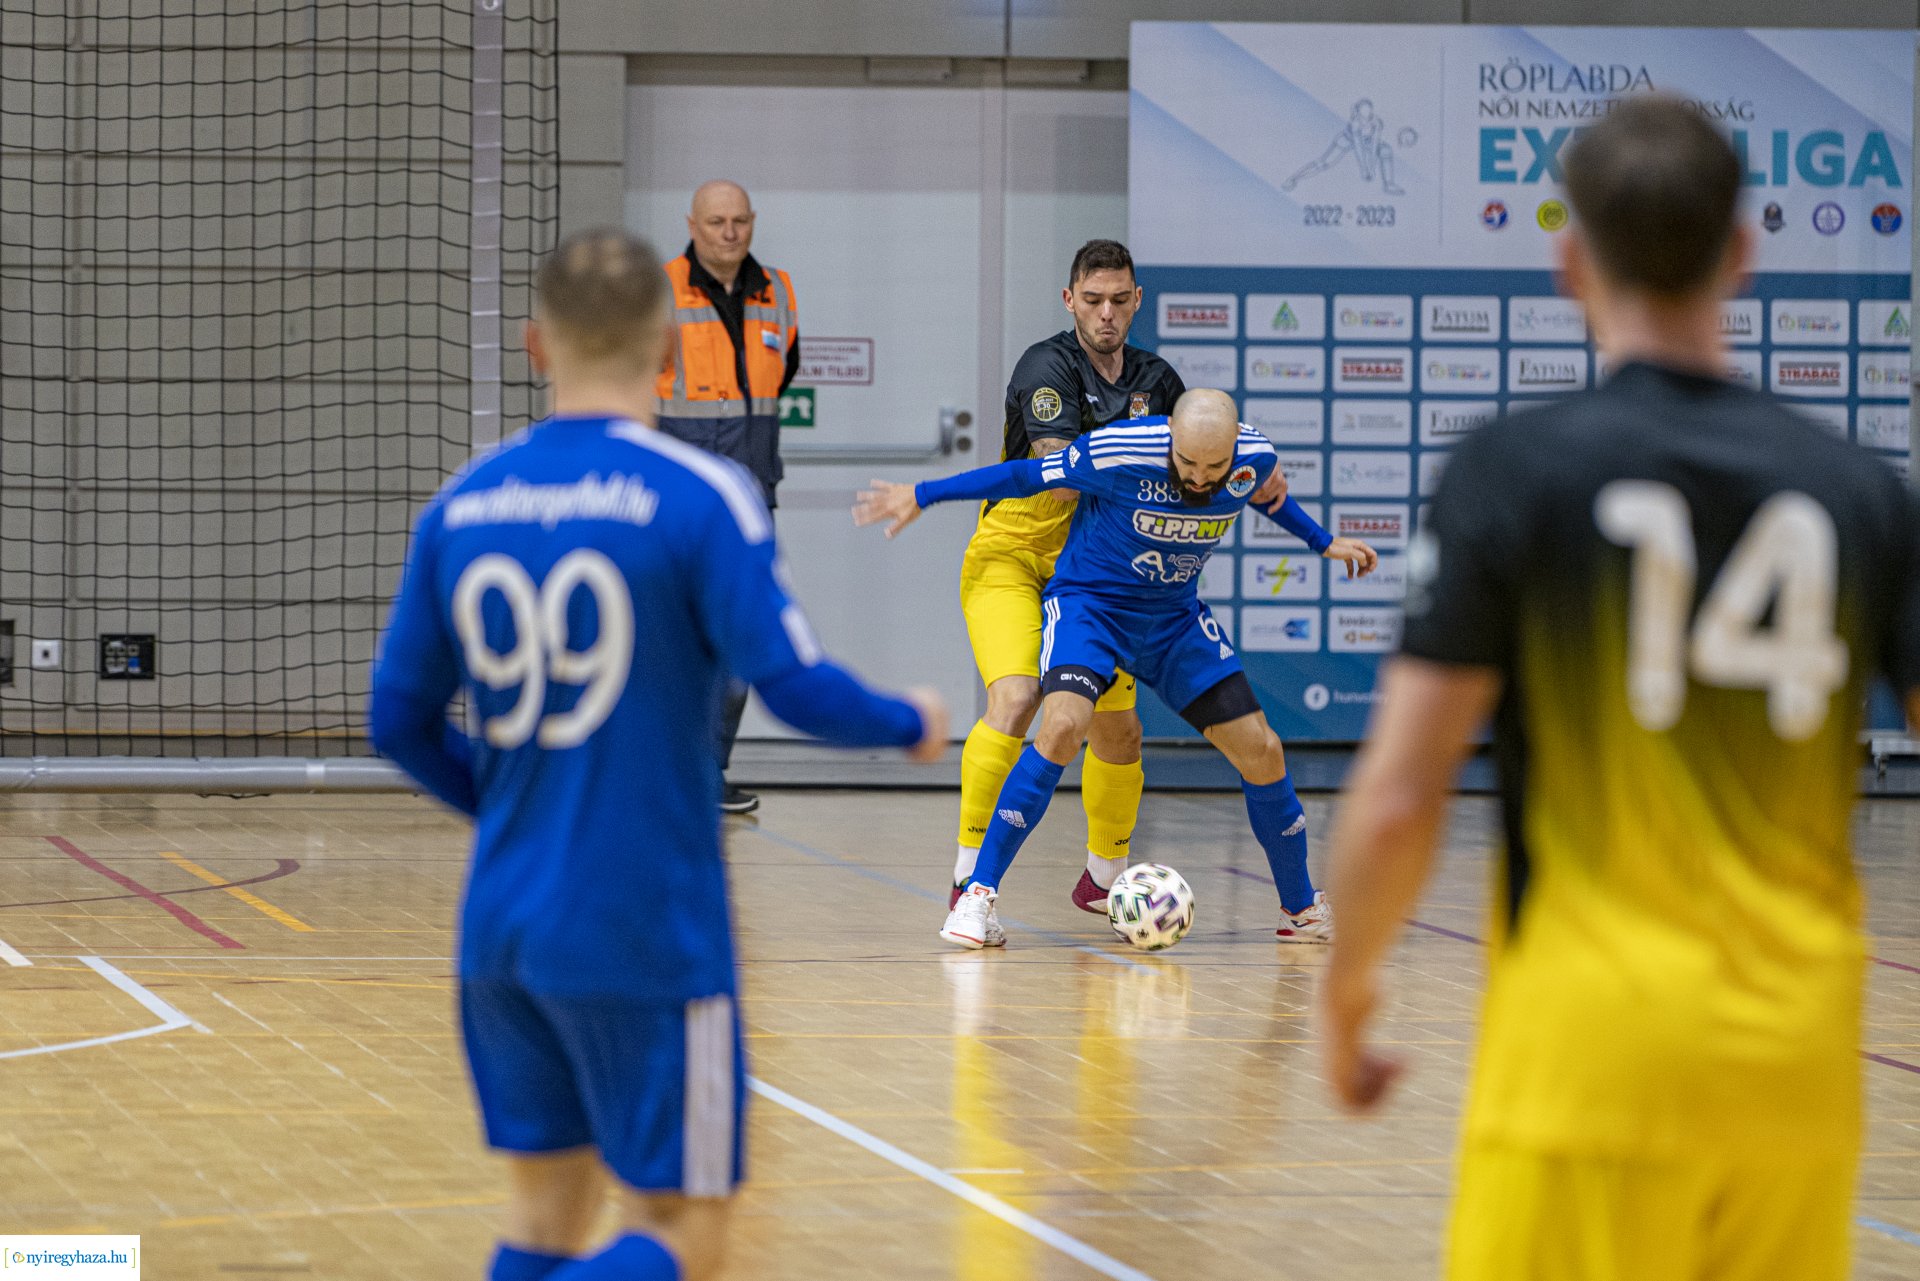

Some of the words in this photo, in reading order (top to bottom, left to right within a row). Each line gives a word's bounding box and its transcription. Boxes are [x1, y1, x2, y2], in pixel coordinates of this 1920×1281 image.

[1479, 56, 1655, 93] RÖPLABDA
[1479, 127, 1903, 189] EXLIGA
[1303, 204, 1343, 226] 2022
[1356, 204, 1397, 227] 2023
[1197, 611, 1221, 642] 6
[1592, 477, 1851, 741] 14
[451, 547, 636, 750] 99
